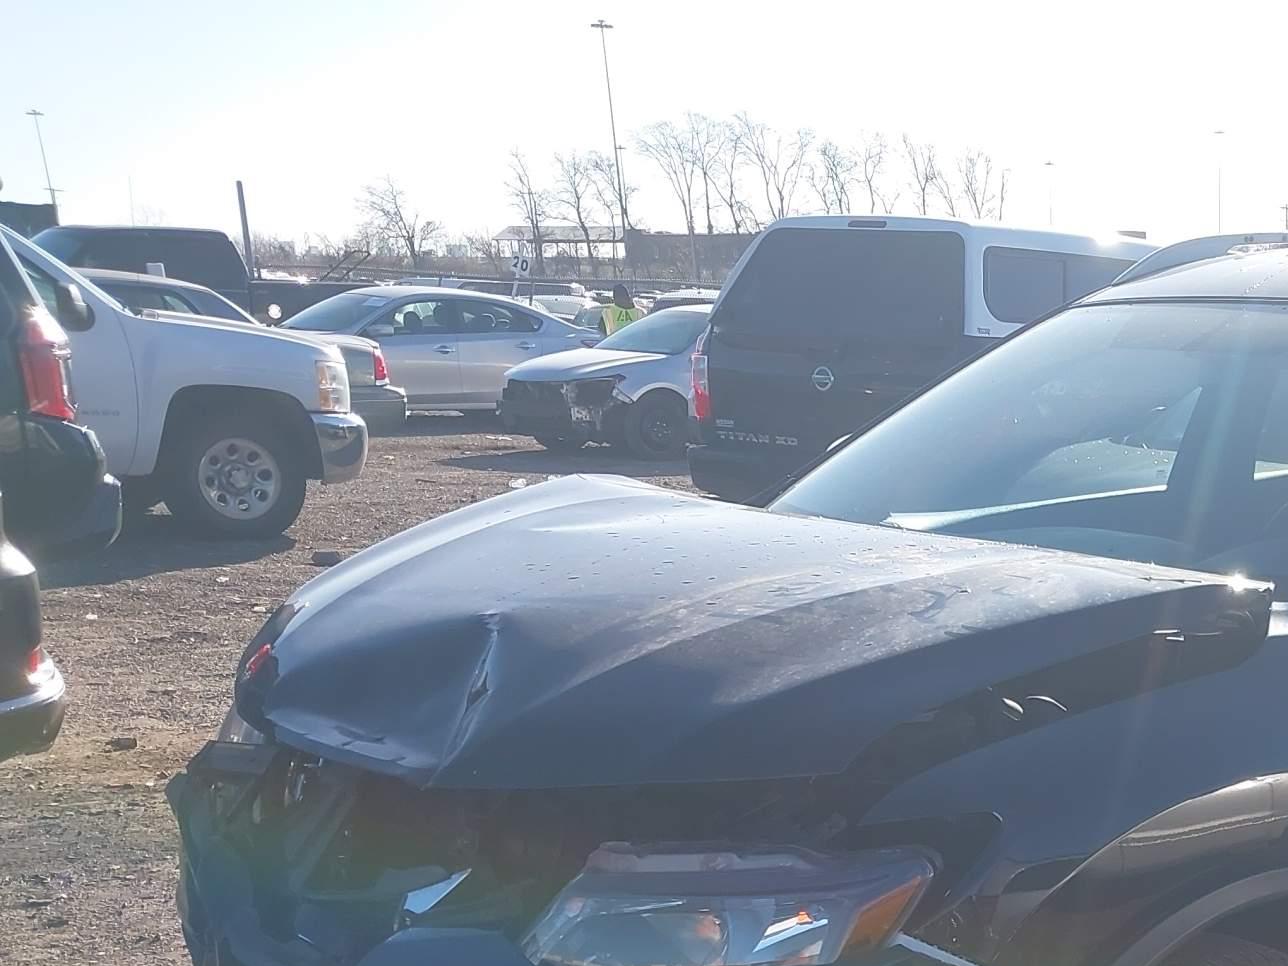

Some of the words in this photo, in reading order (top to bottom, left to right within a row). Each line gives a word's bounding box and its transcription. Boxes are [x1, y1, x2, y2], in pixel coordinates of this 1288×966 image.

[512, 255, 529, 272] 20
[716, 431, 769, 443] TITAN
[775, 435, 798, 446] XD
